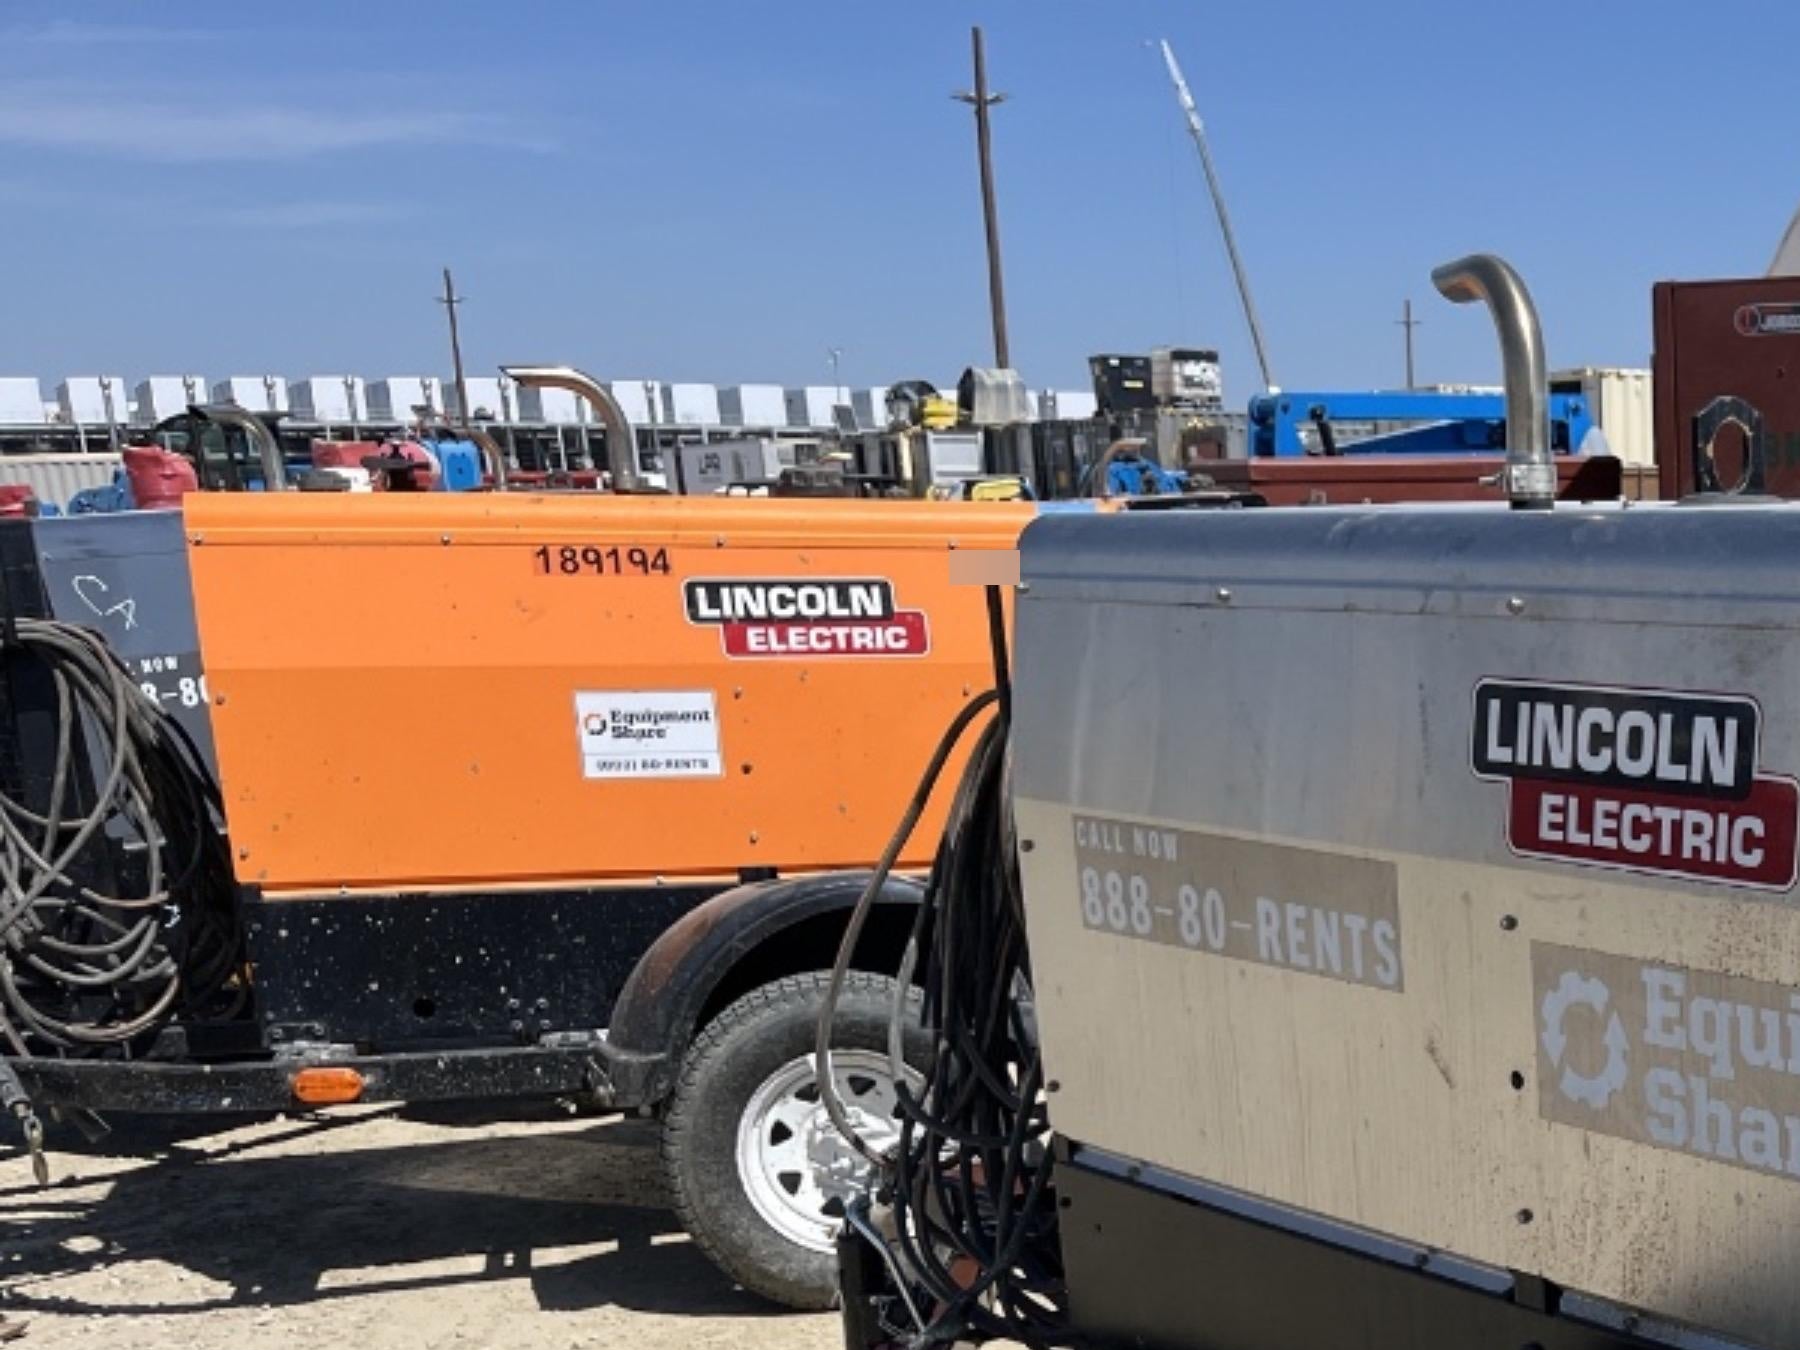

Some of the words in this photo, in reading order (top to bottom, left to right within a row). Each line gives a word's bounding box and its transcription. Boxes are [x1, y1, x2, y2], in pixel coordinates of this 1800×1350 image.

[534, 545, 671, 576] 189194
[695, 585, 883, 618] LINCOLN
[746, 626, 909, 652] ELECTRIC
[610, 708, 709, 726] Equipment
[1487, 698, 1738, 787] LINCOLN
[1077, 821, 1123, 853] CALL
[1134, 827, 1178, 862] NOW
[1538, 793, 1765, 868] ELECTRIC
[1082, 866, 1399, 986] 888-80-RENTS
